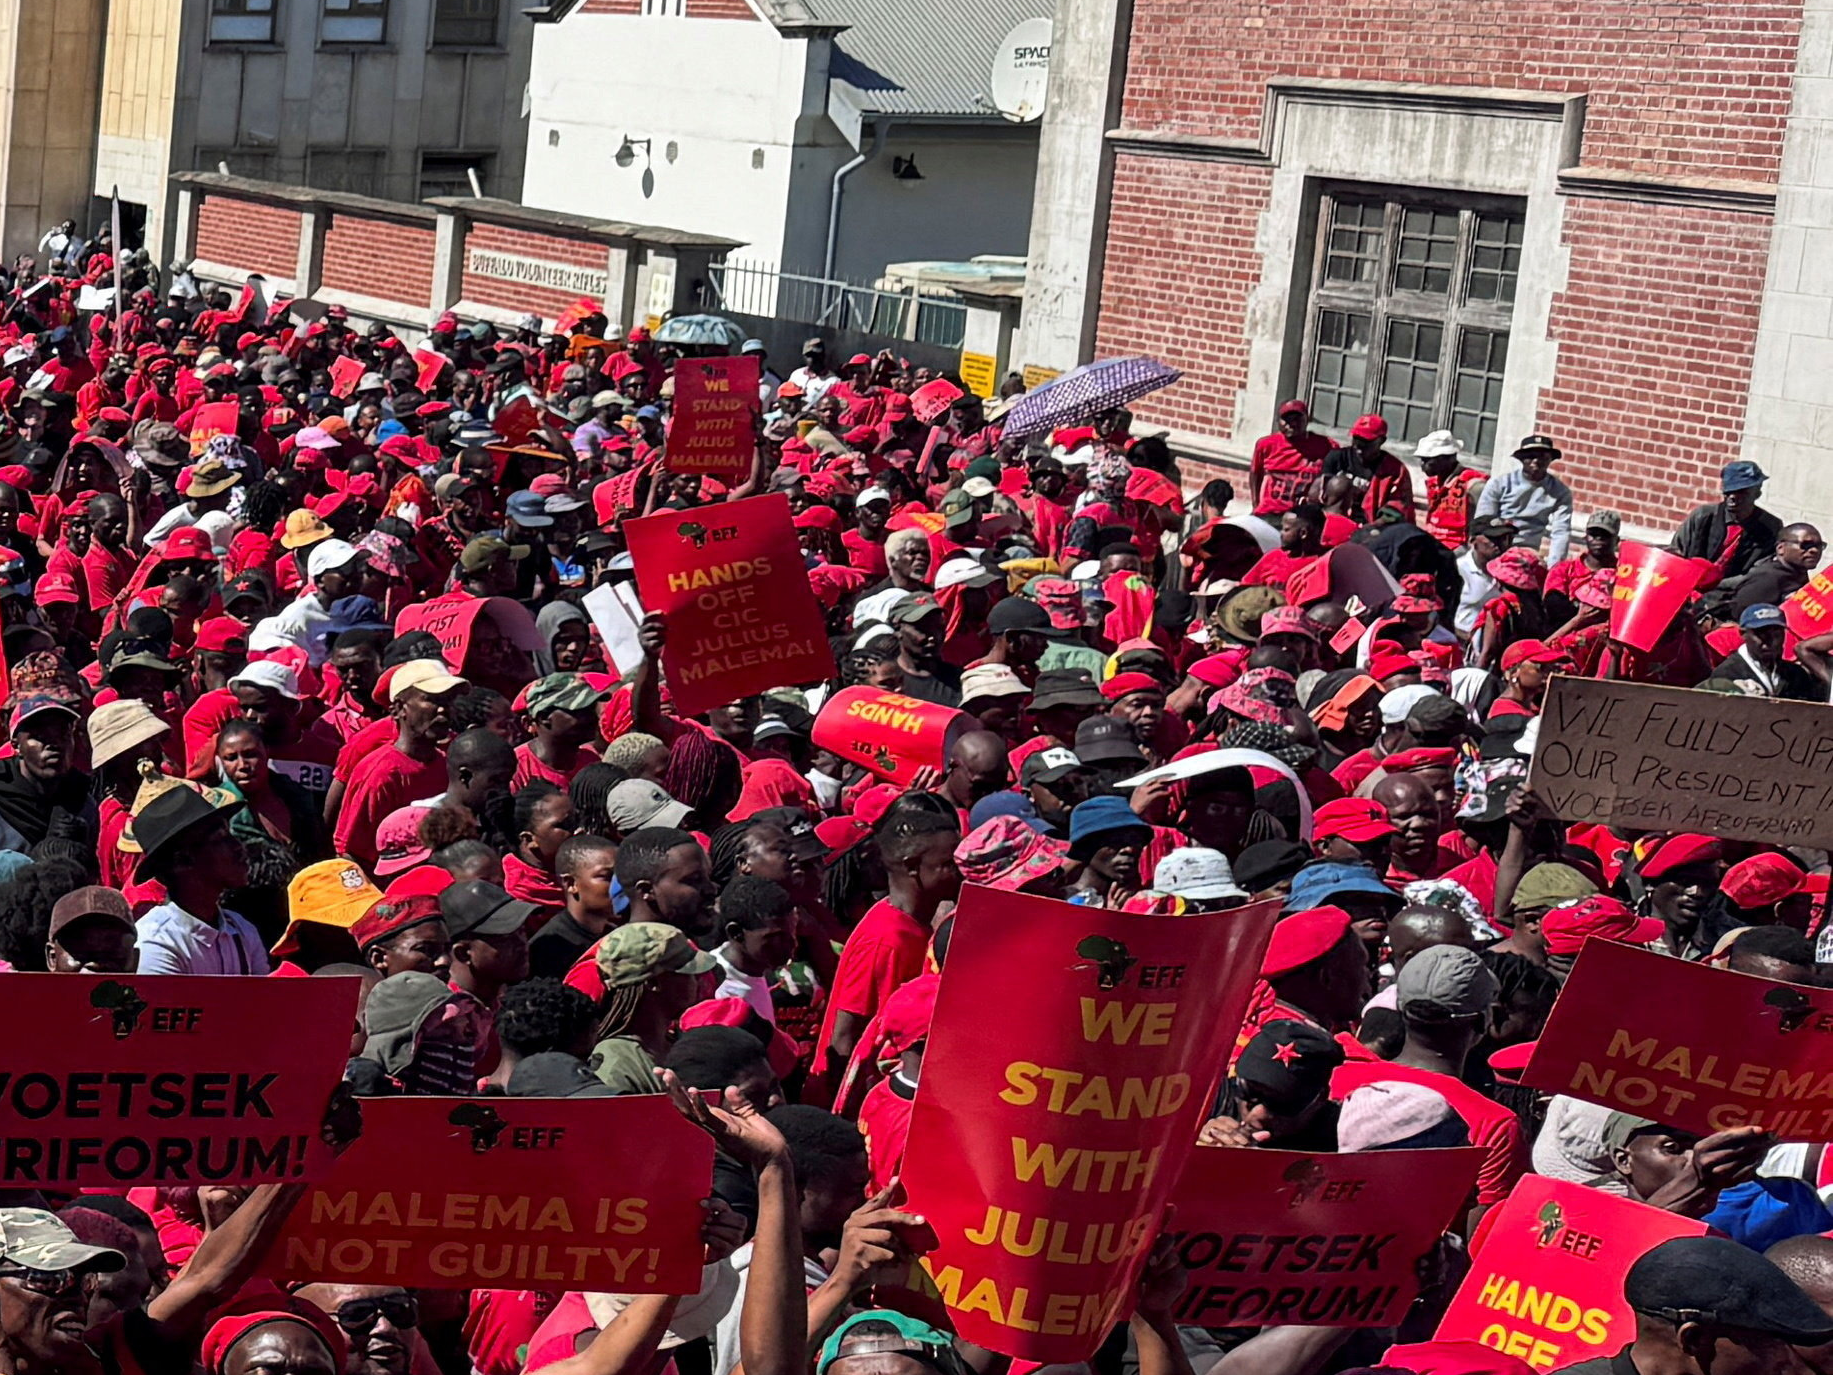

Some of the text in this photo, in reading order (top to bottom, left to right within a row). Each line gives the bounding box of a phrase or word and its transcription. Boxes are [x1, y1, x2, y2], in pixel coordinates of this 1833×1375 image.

[472, 253, 515, 277] BUFFALO
[704, 379, 730, 393] WE
[692, 398, 743, 413] STAND
[685, 434, 736, 449] JULIUS
[695, 417, 734, 431] WITH
[670, 454, 745, 469] MALEMA!
[667, 556, 773, 593] HANDS
[697, 584, 756, 611] OFF
[713, 607, 761, 629] CIC
[690, 622, 791, 657] JULIUS
[679, 638, 816, 685] MALEMA!
[846, 700, 925, 735] HANDS
[1558, 691, 1625, 739] WE
[1635, 701, 1750, 756] FULLY
[299, 765, 322, 787] 22
[1540, 741, 1619, 785] OUR
[1634, 755, 1822, 808] PRESIDENT
[1138, 963, 1186, 989] EFF
[152, 1006, 204, 1033] EFF
[1079, 995, 1177, 1046] WE
[998, 1061, 1192, 1121] STAND
[1569, 1061, 1697, 1117] NOT
[512, 1127, 566, 1150] EFF
[1011, 1136, 1160, 1193] WITH
[1321, 1179, 1367, 1202] EFF
[309, 1190, 650, 1235] MALEMA IS
[964, 1205, 1154, 1265] JULIUS
[1175, 1230, 1396, 1274] OETSEK
[1561, 1229, 1603, 1259] EFF
[283, 1235, 661, 1284] NOT GUILTY!
[1176, 1284, 1401, 1322] IFORUM!
[1477, 1272, 1613, 1346] HANDS
